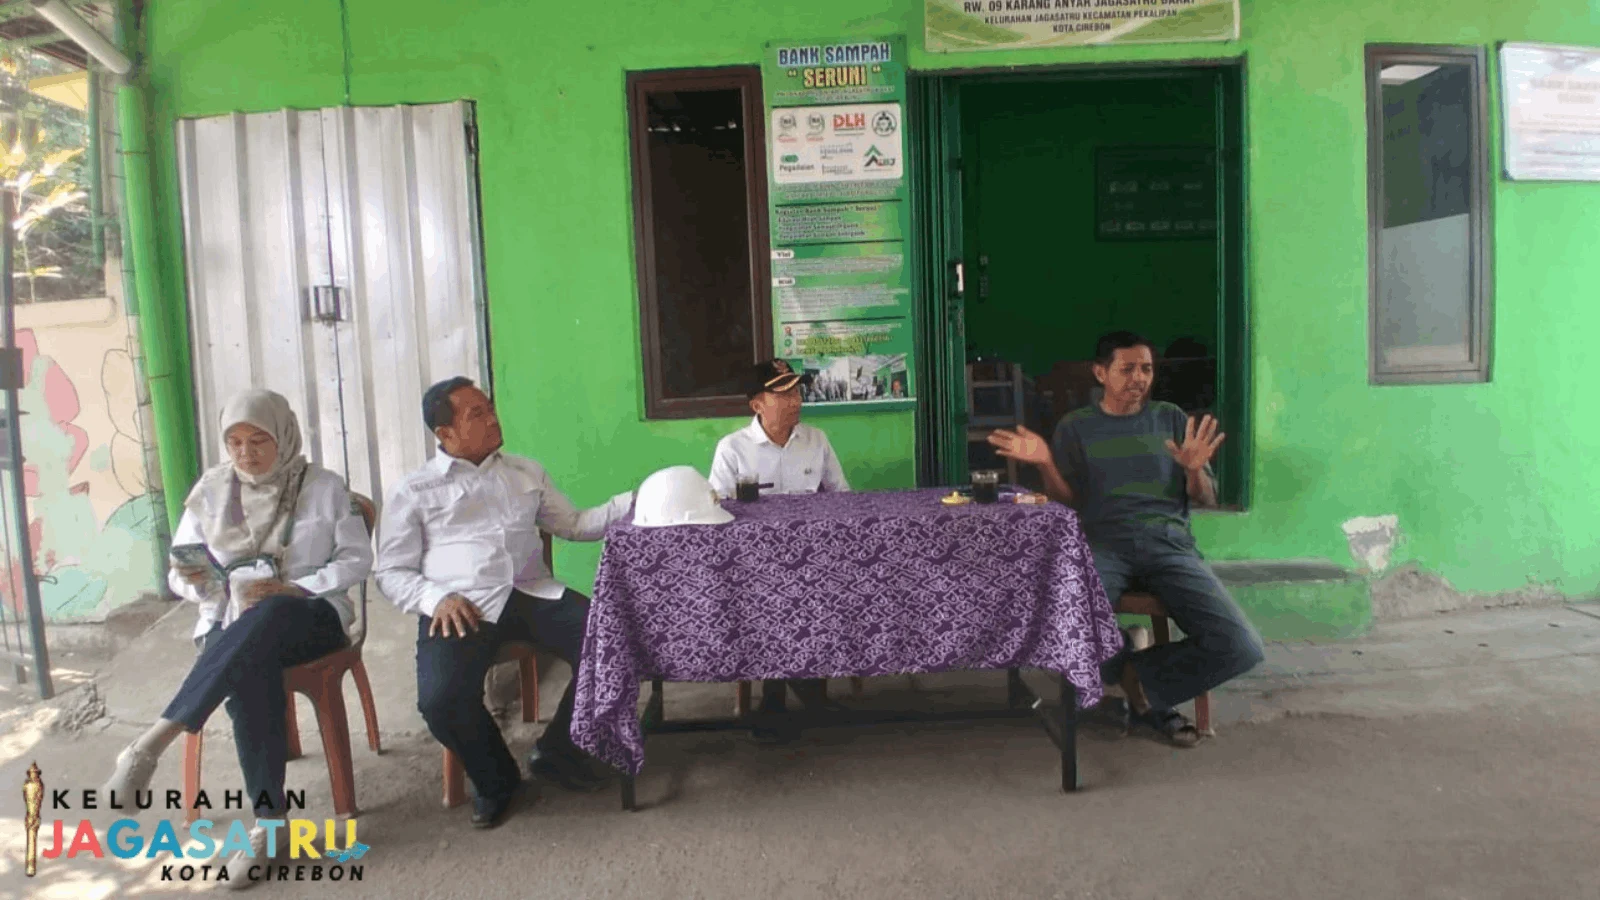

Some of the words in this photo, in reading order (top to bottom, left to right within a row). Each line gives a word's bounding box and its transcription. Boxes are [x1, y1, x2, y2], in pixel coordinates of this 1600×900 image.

[964, 1, 984, 12] RW.
[988, 0, 1002, 11] 09
[1006, 0, 1050, 10] KARANG
[985, 15, 1032, 24] KELURAHAN
[1035, 12, 1080, 22] JAGASATRU
[1083, 10, 1131, 20] KECAMATAN
[1133, 9, 1177, 18] PEKALIPAN
[1053, 24, 1075, 33] KOTA
[1076, 22, 1111, 32] CIREBON
[779, 46, 820, 65] BANK
[825, 43, 891, 63] SAMPAH
[803, 65, 868, 88] SERUNI
[833, 113, 866, 129] DLH
